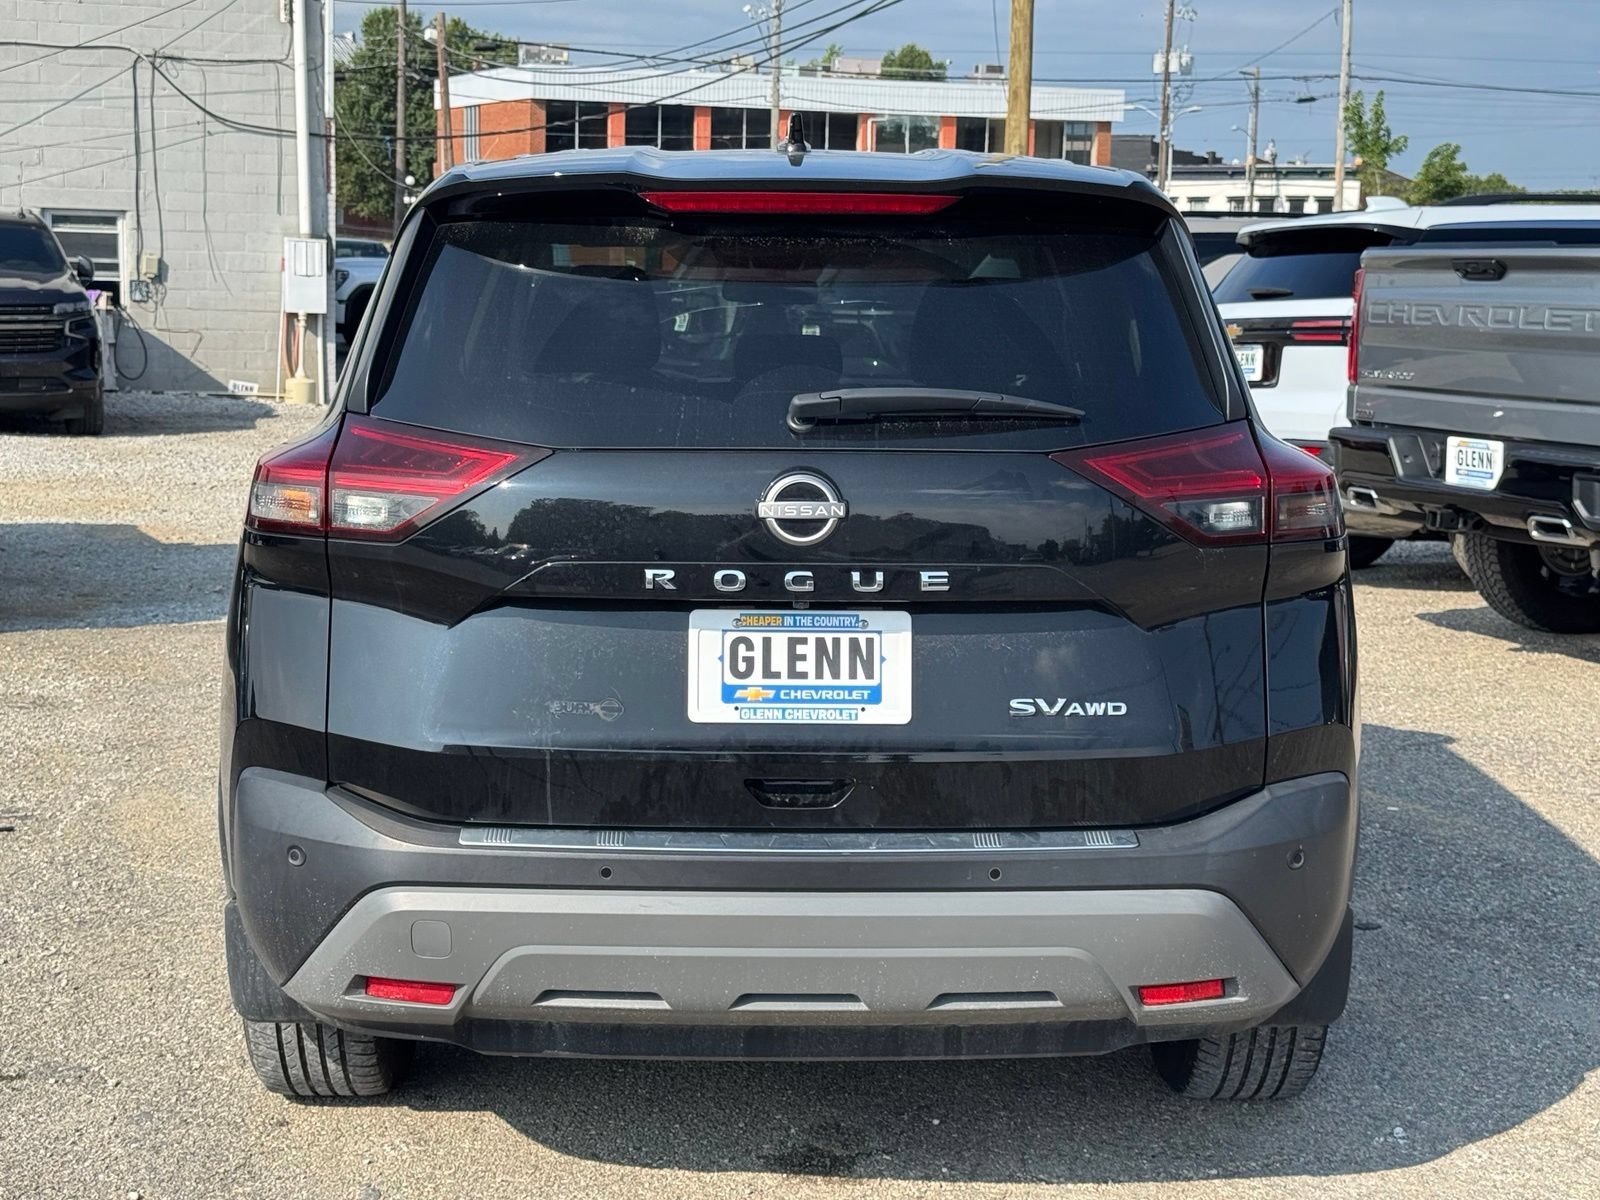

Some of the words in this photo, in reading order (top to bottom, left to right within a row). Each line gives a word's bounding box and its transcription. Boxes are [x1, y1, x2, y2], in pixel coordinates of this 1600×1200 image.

[1368, 302, 1600, 332] CHEVROLET
[1457, 449, 1493, 470] GLENN
[761, 505, 844, 516] NISSAN
[644, 568, 950, 592] ROGUE
[740, 616, 782, 627] CHEAPER
[783, 616, 794, 627] IN
[795, 616, 813, 627] THE
[814, 616, 858, 627] COUNTRY.
[729, 636, 874, 680] GLENN
[780, 689, 871, 700] CHEVROLET
[741, 709, 783, 720] GLENN
[784, 709, 858, 721] CHEVROLET
